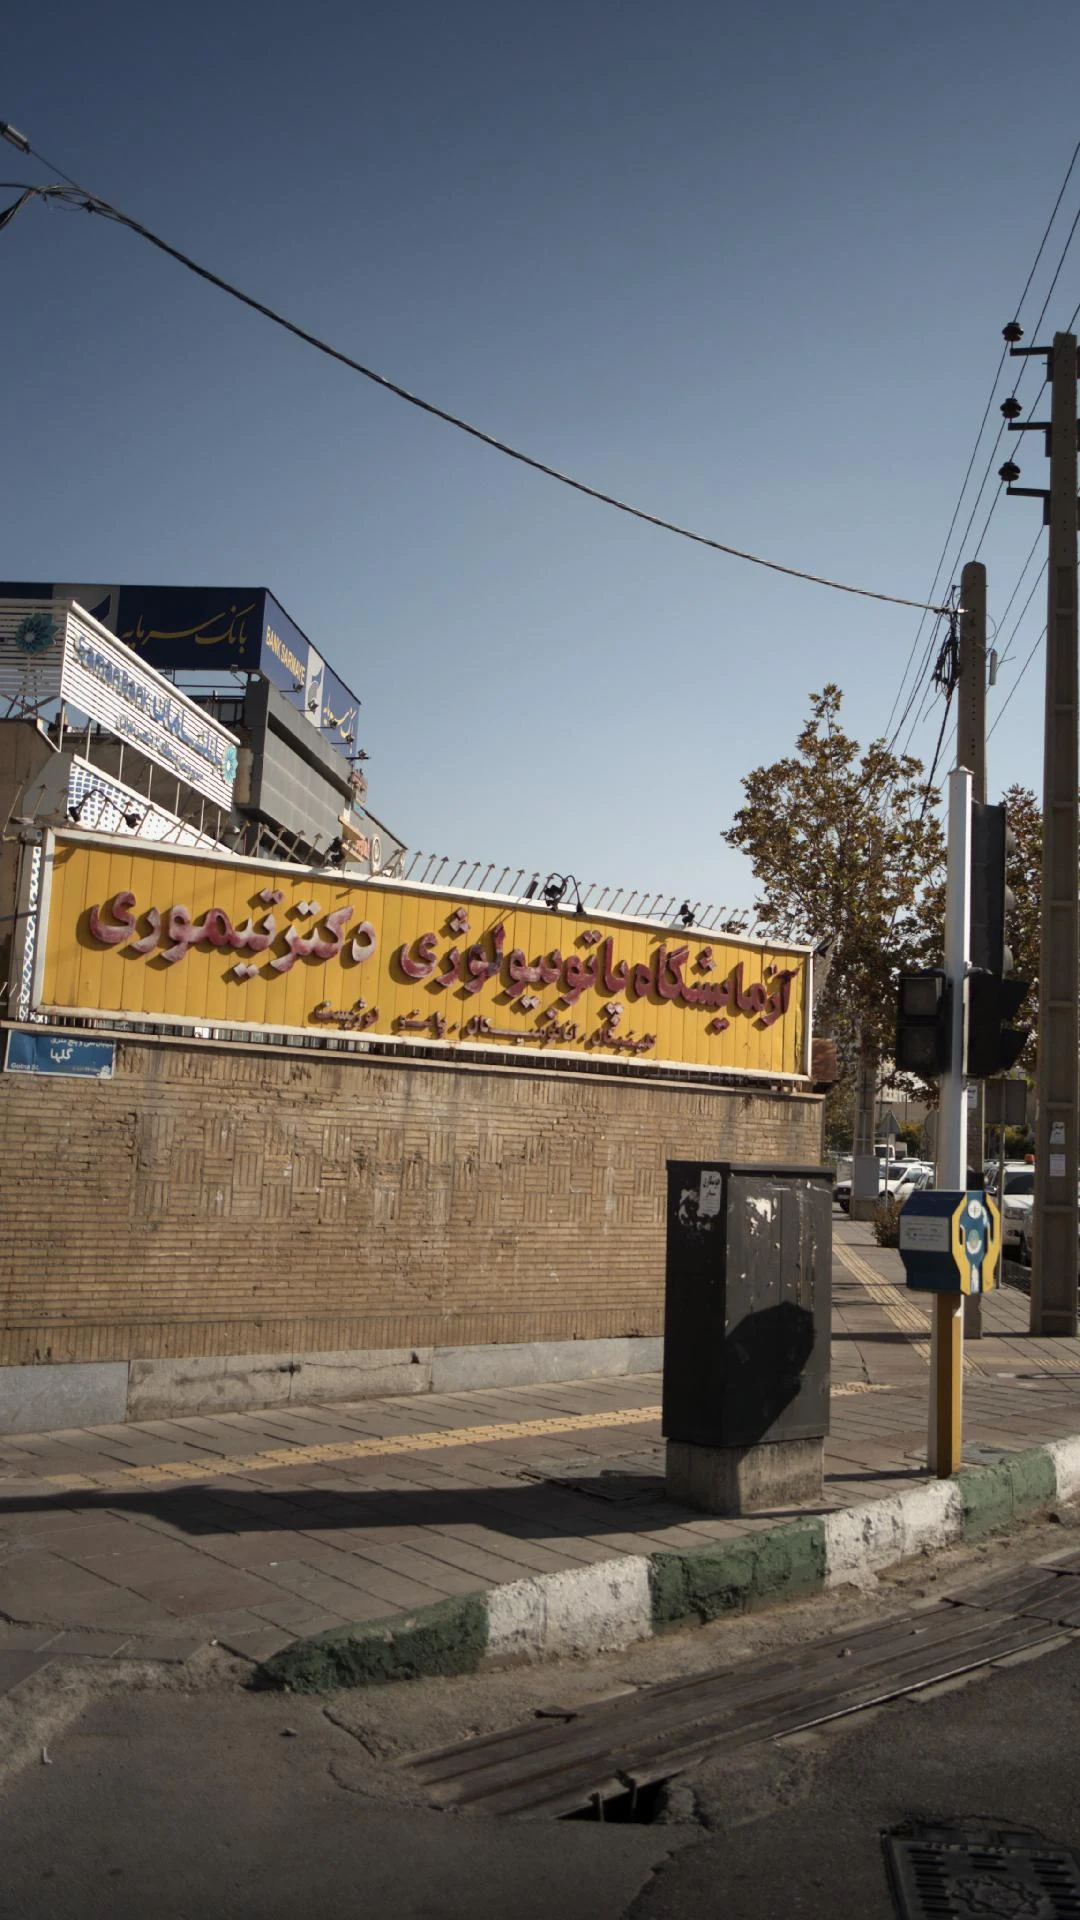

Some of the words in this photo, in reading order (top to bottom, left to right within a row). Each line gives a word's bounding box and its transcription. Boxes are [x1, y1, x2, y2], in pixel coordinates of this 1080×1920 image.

[195, 603, 256, 654] بانک
[265, 624, 282, 660] BANK
[90, 888, 285, 980] تیموری
[270, 900, 377, 973] دکتر
[401, 906, 629, 1026] پاتوبیولوژی
[635, 943, 799, 1031] آزمایشگاه
[50, 1047, 74, 1063] گلها
